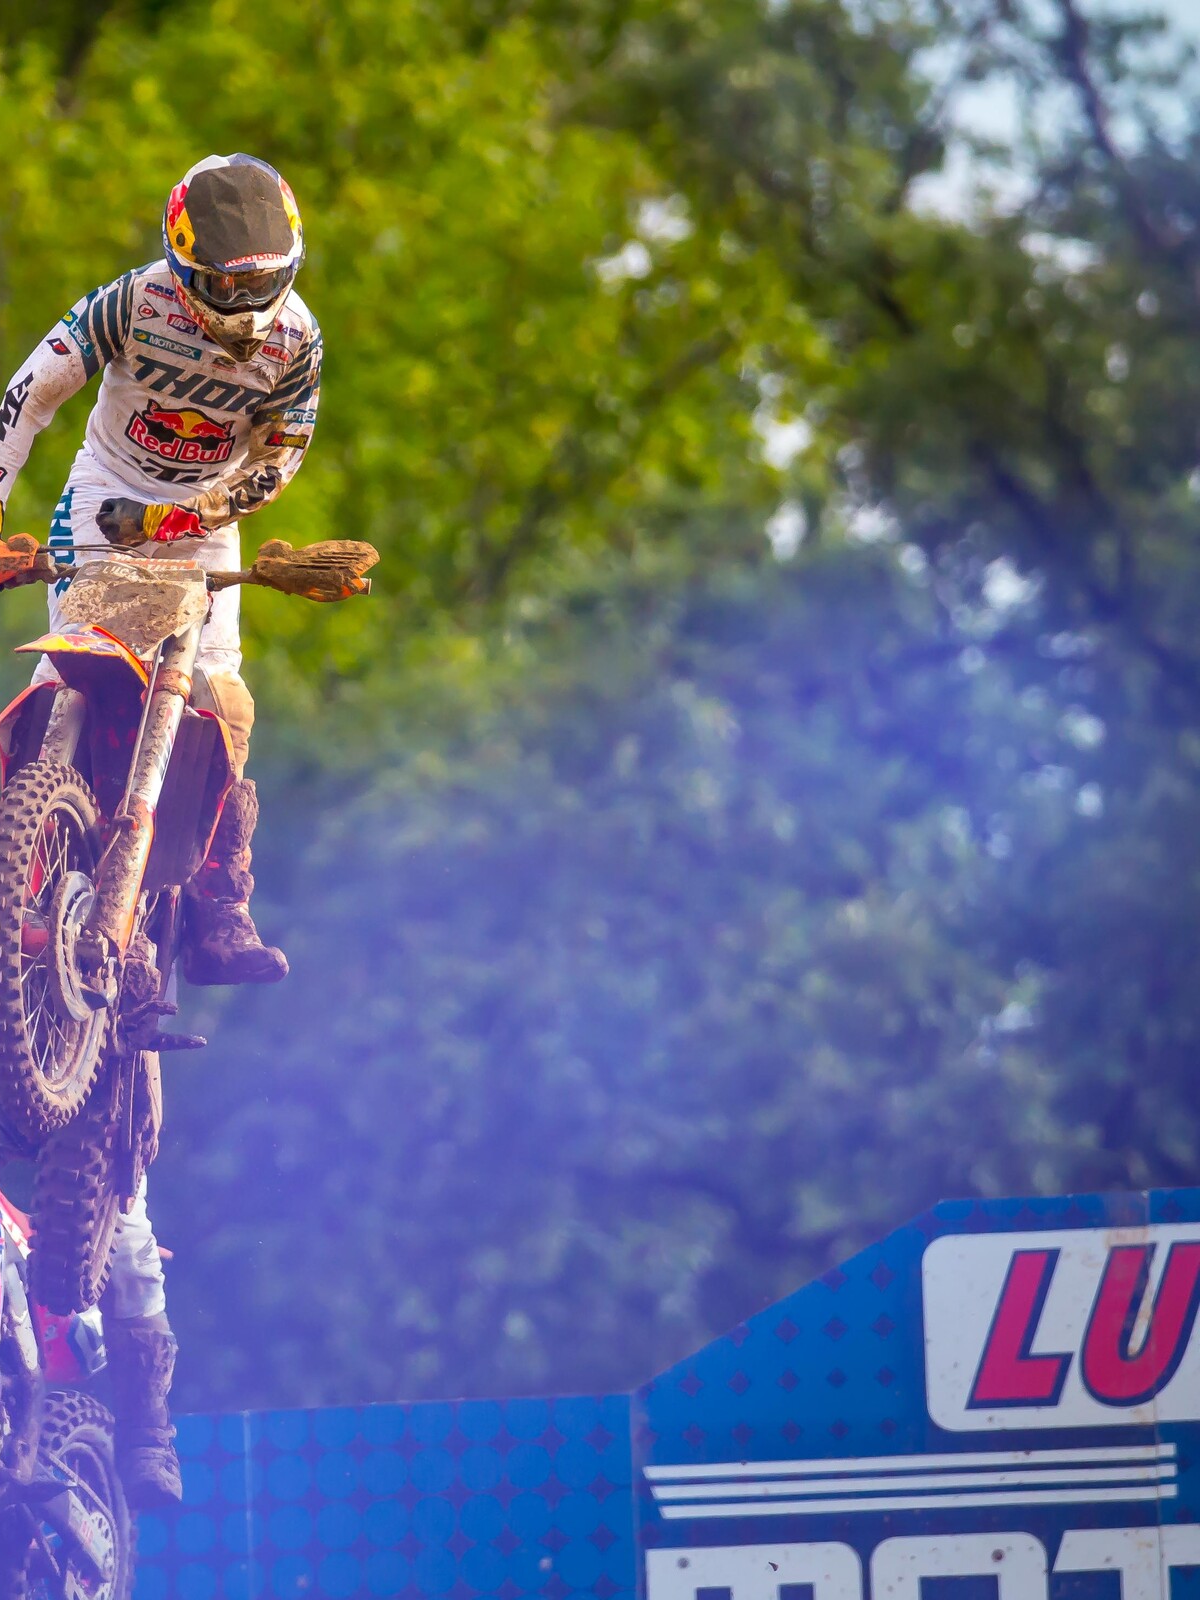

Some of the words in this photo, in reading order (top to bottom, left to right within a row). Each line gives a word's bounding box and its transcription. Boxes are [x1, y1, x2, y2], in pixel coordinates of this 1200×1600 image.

[169, 316, 197, 334] 100%
[148, 334, 196, 358] MOTOREX
[128, 415, 182, 459] Red
[178, 440, 233, 462] Bull
